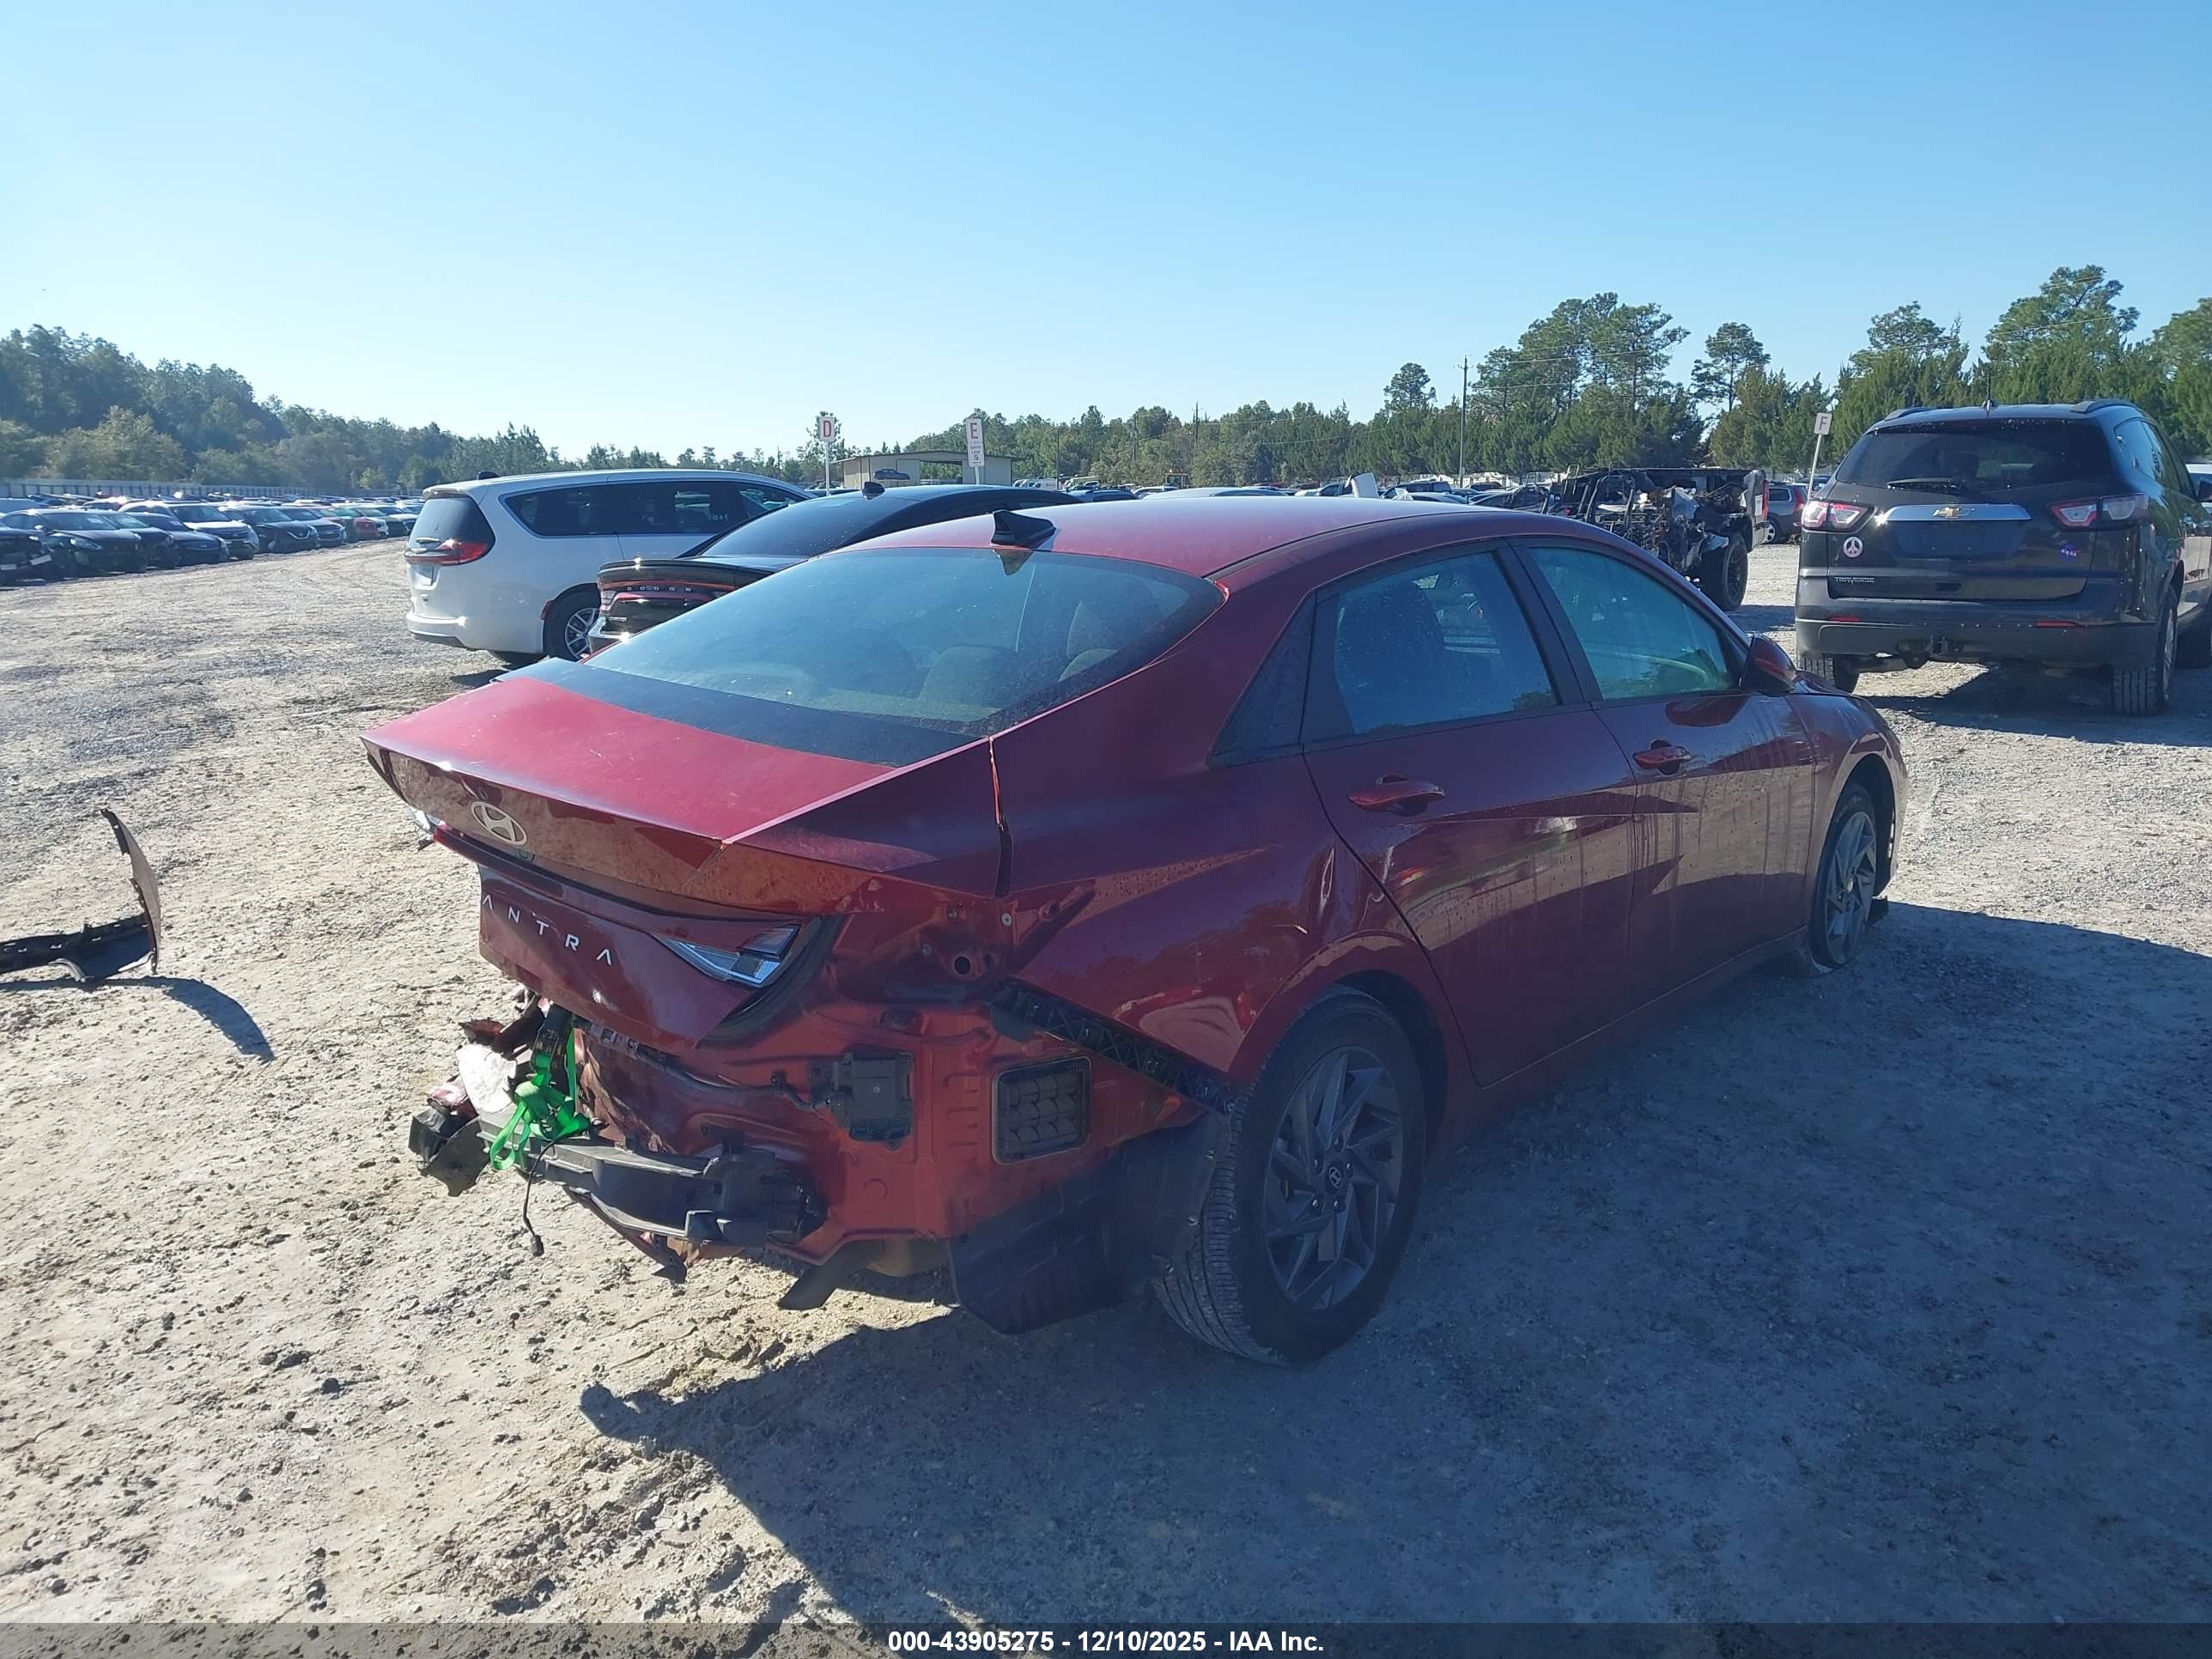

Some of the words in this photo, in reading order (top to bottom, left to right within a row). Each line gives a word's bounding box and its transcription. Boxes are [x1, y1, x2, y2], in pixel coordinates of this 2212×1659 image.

[823, 420, 832, 438] D
[969, 422, 979, 439] E
[1819, 416, 1828, 430] F
